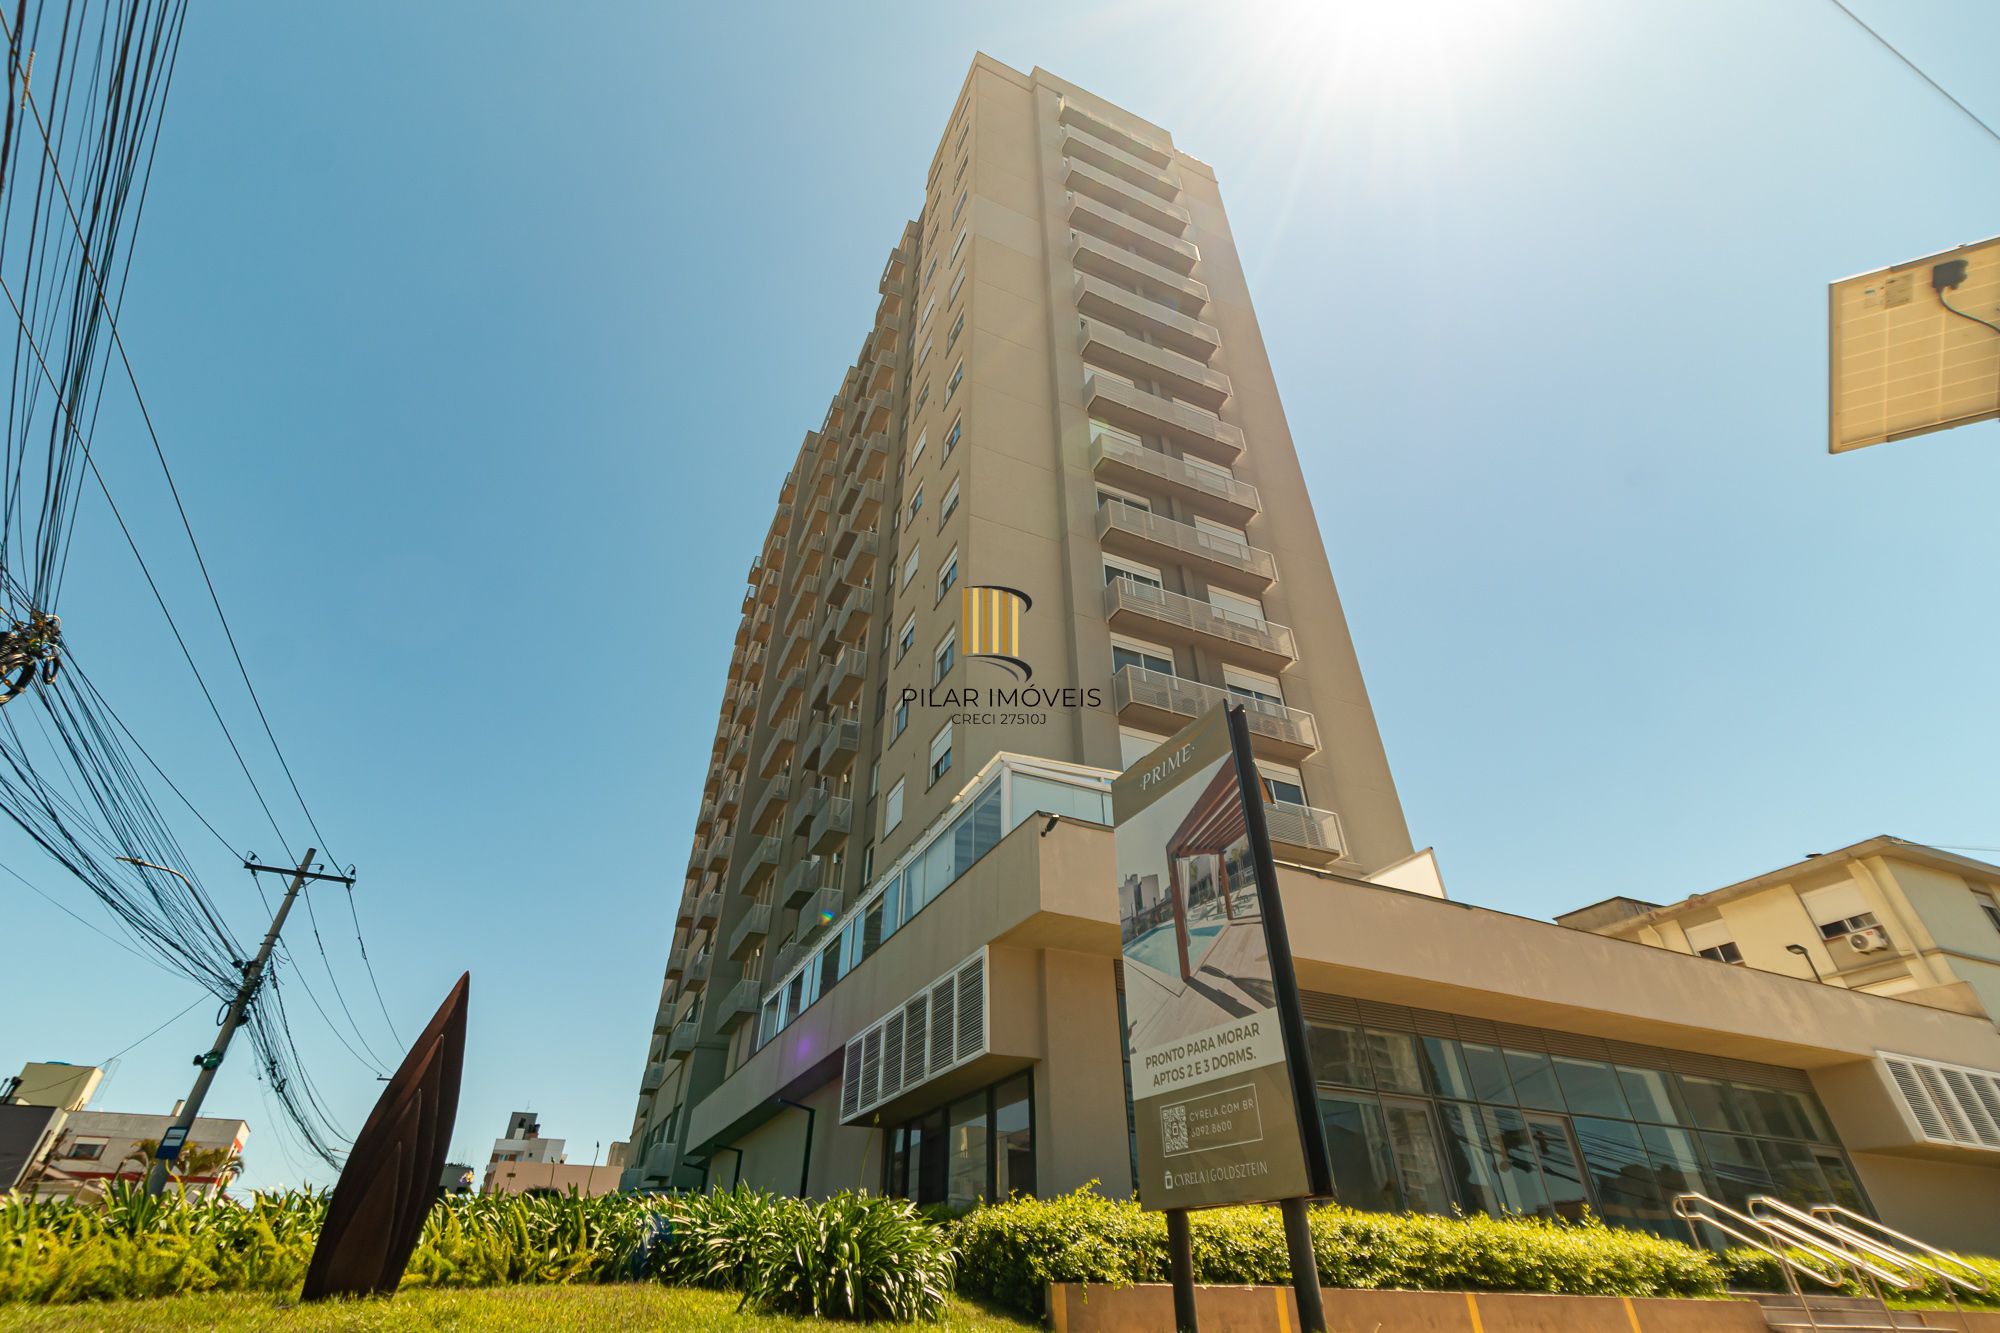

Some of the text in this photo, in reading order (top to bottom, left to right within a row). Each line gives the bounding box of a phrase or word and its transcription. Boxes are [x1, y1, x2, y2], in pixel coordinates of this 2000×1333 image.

[1145, 1022, 1260, 1069] PRONTO PARA MORAR
[1153, 1046, 1256, 1087] APTOS 2 E 3 DORMS.
[1210, 1160, 1268, 1182] GOLDSZTEIN
